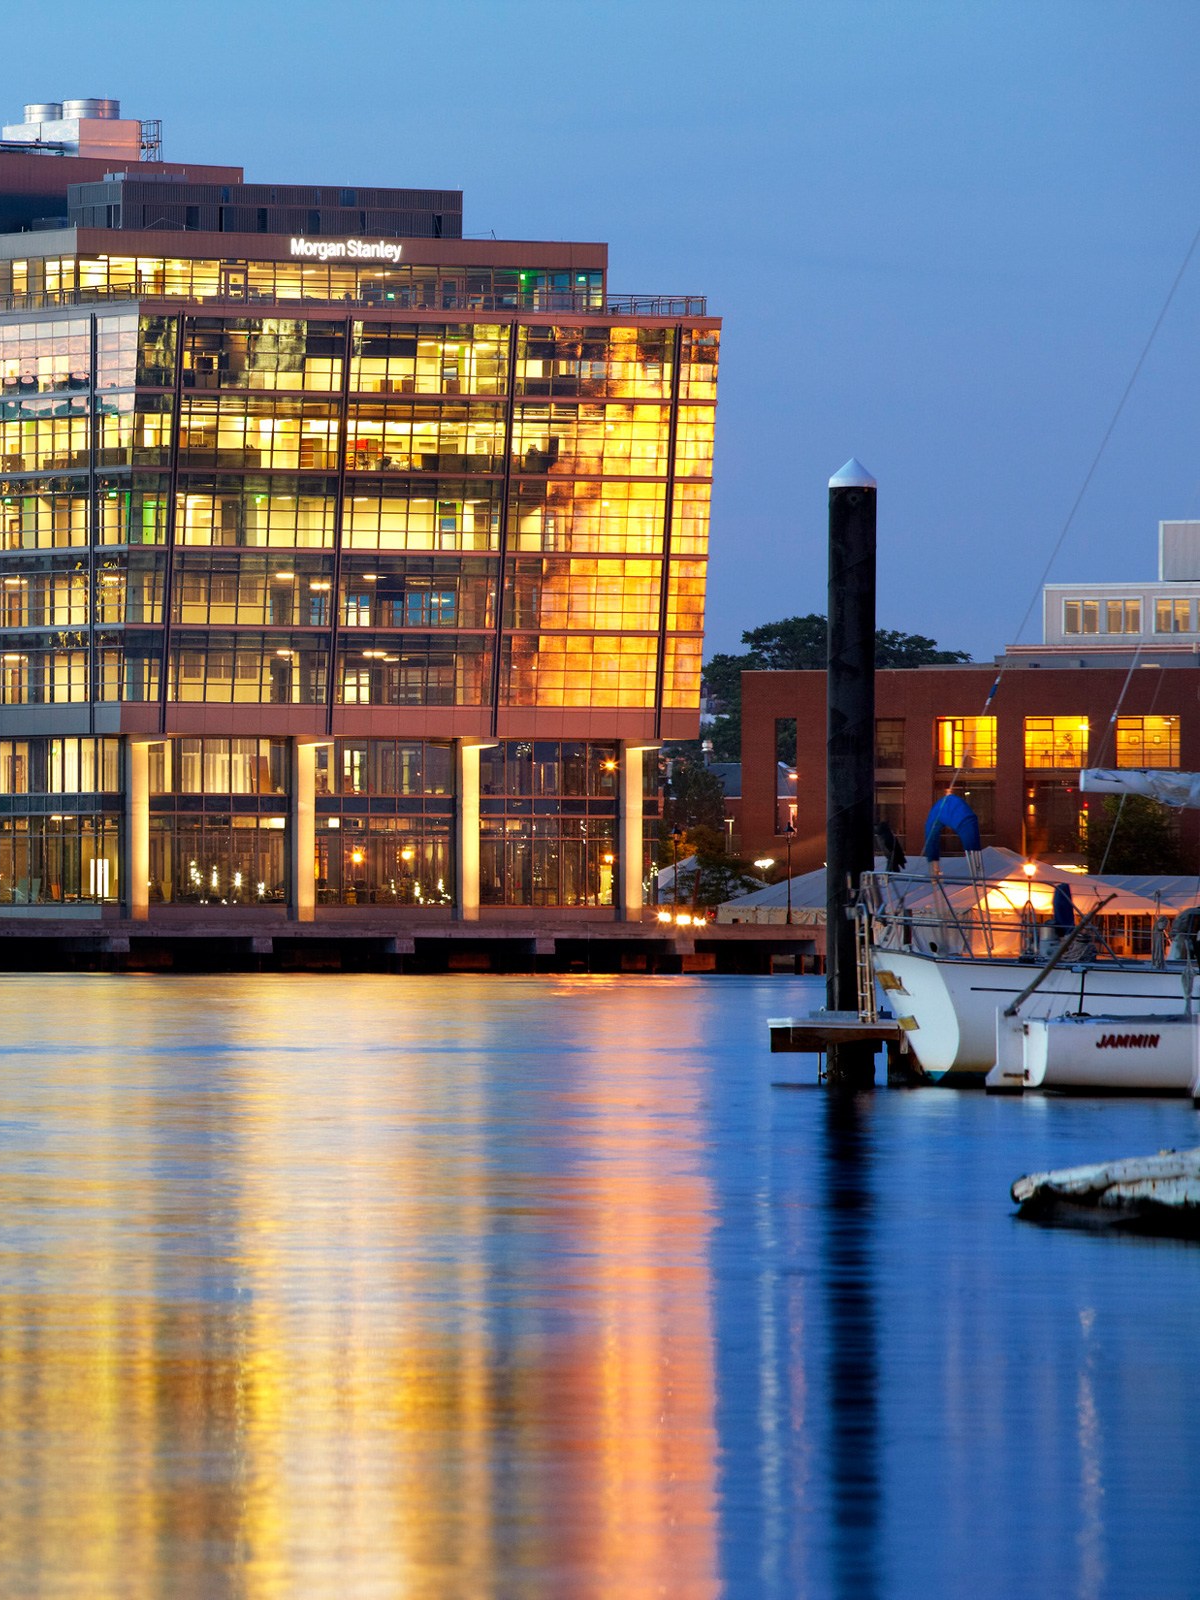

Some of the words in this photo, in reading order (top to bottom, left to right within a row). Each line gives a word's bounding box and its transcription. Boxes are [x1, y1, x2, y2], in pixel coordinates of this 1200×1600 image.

[291, 238, 345, 260] Morgan
[347, 239, 402, 262] Stanley
[1095, 1034, 1160, 1049] JAMMIN
